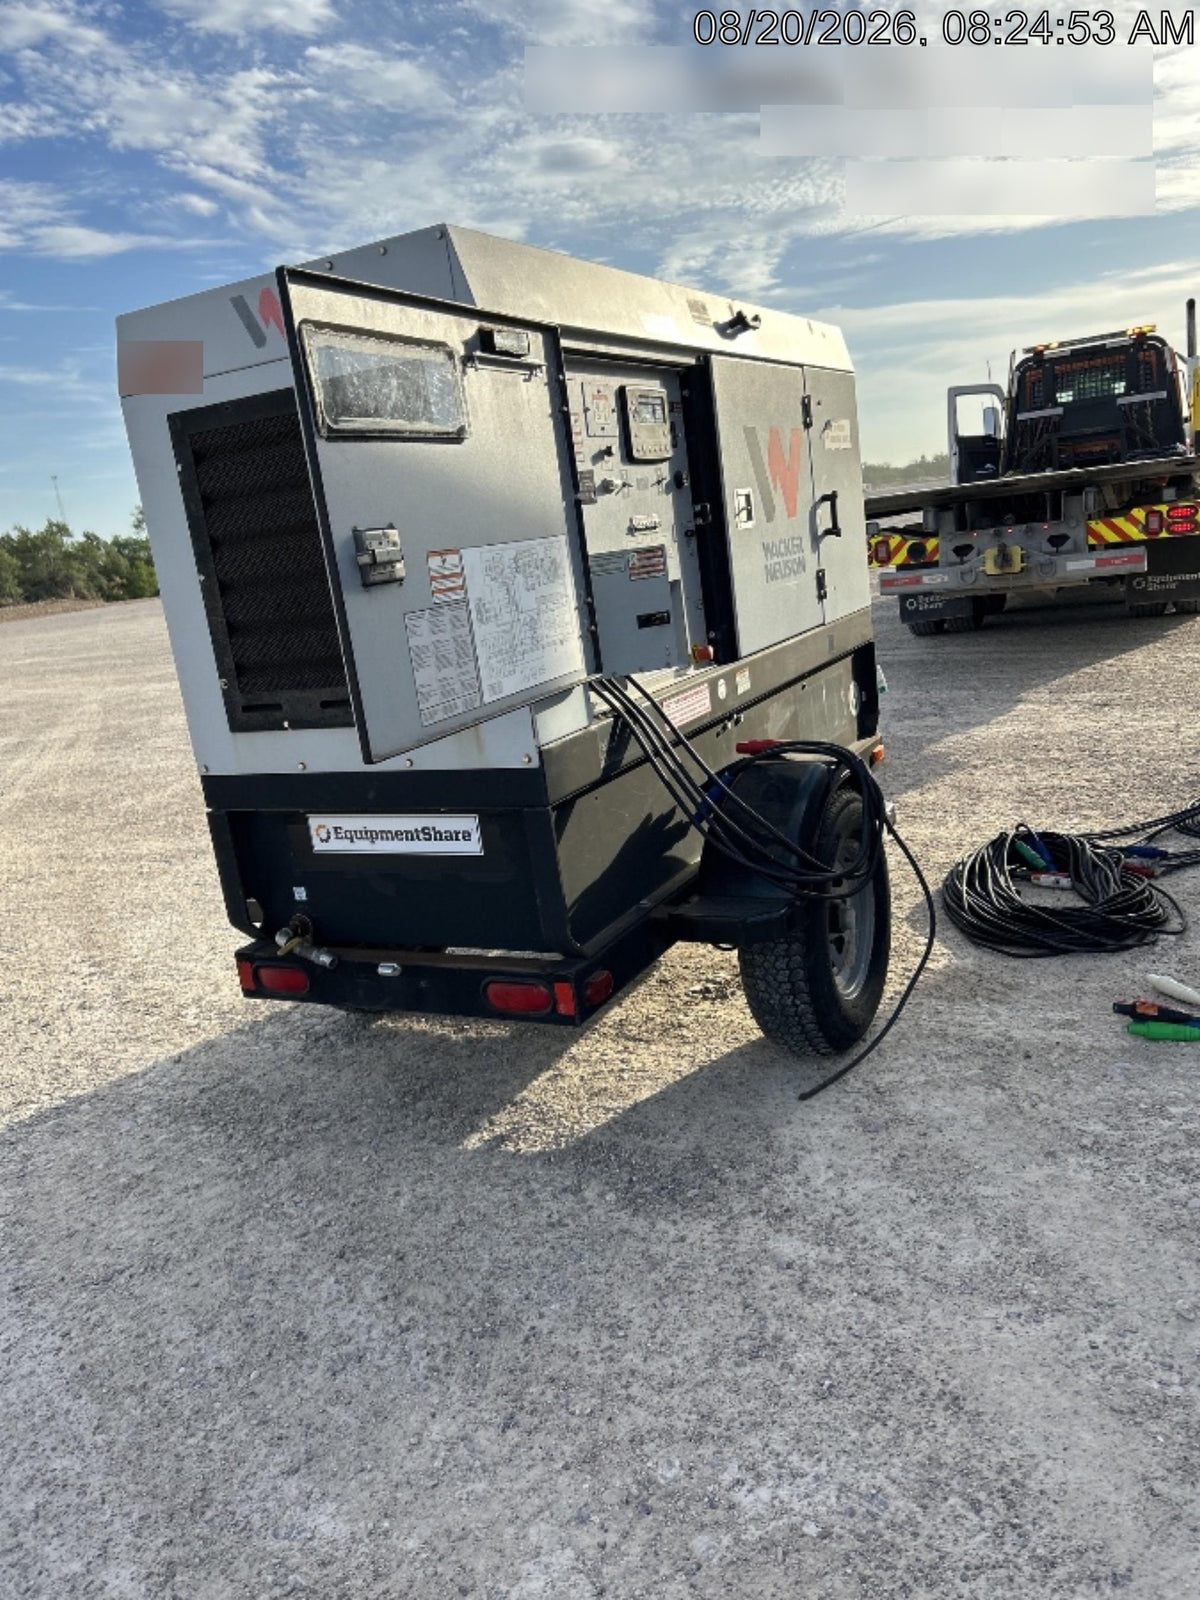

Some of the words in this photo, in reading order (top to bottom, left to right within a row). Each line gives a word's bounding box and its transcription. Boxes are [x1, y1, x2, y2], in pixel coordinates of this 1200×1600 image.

[762, 536, 804, 562] WACKER
[764, 555, 807, 584] NEUSON
[332, 826, 473, 844] EquipmentShare
